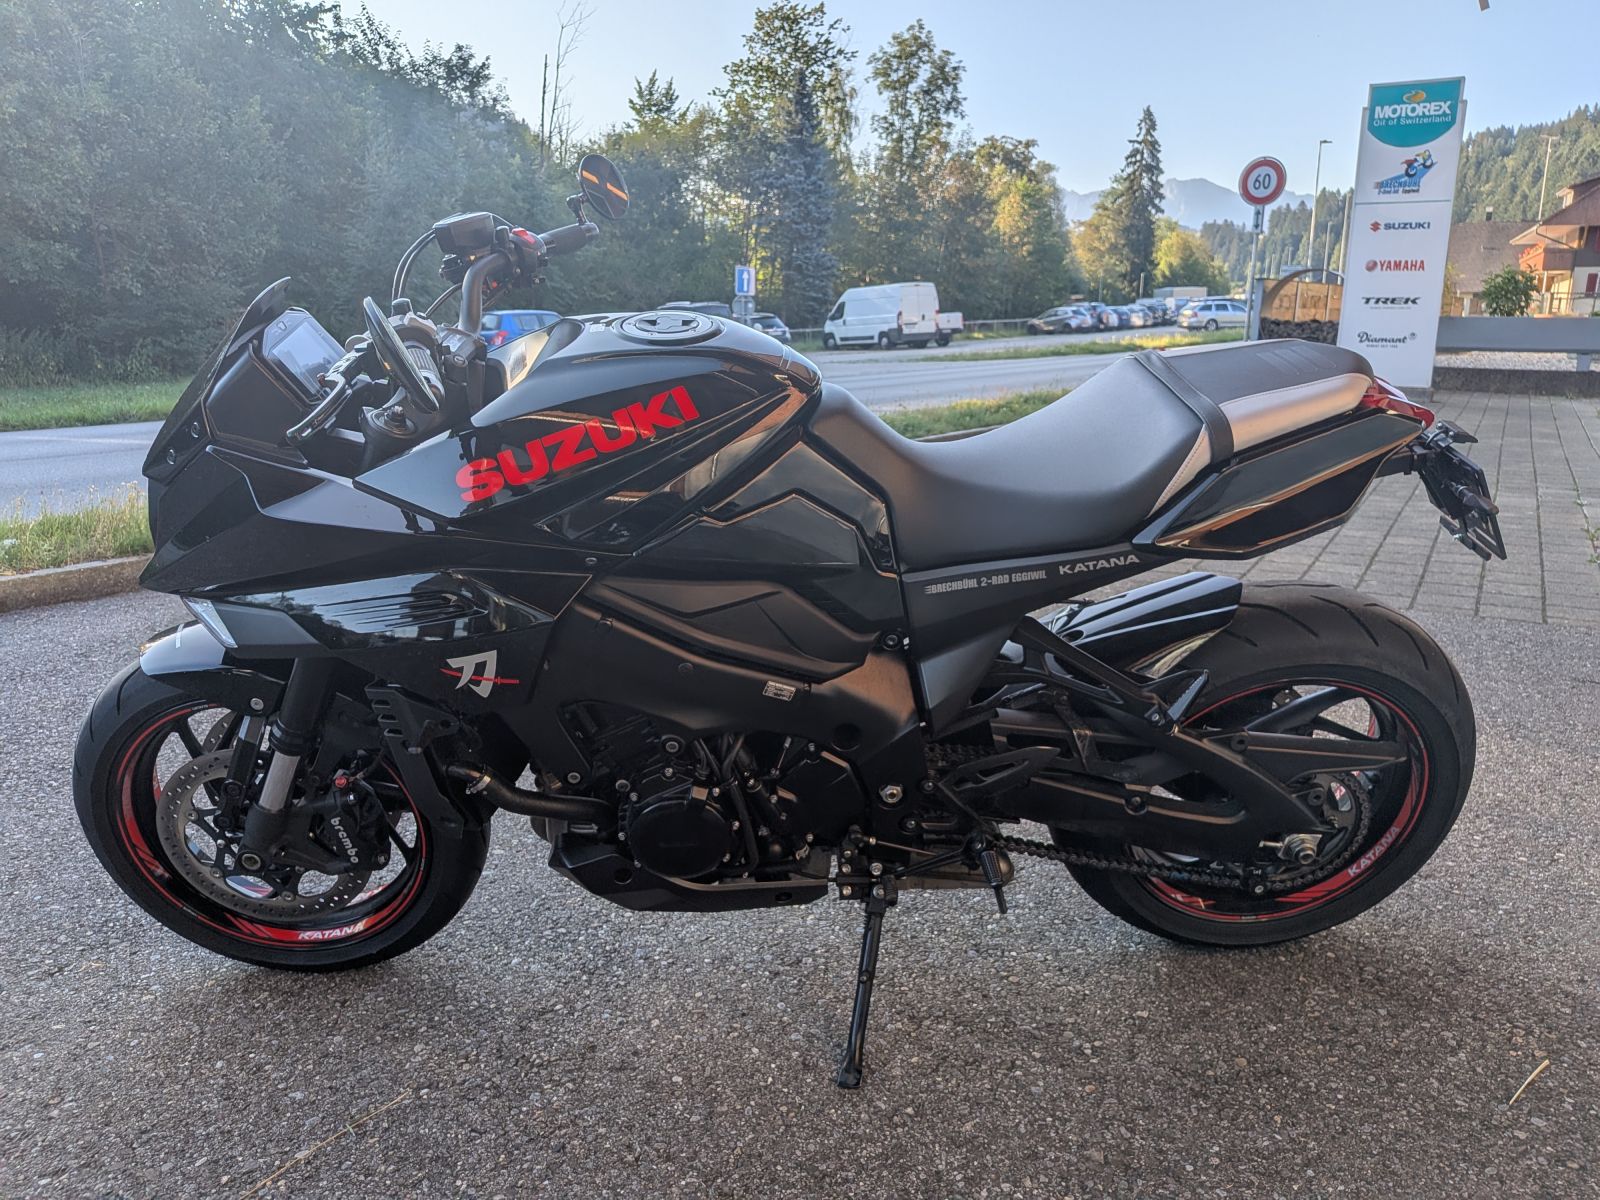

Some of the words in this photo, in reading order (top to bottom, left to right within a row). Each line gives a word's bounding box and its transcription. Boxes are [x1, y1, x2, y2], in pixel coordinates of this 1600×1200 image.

[1374, 101, 1452, 119] MOTOREX
[1388, 118, 1397, 126] of
[1400, 115, 1452, 126] Switzerland
[1253, 173, 1271, 190] 60
[1383, 221, 1431, 230] SUZUKI
[1379, 259, 1425, 272] YAMAHA
[1361, 296, 1421, 305] TREK
[1357, 331, 1408, 343] Diamant
[455, 385, 699, 502] SUZUKI
[1058, 554, 1140, 575] KATANA
[929, 577, 978, 594] BRECHBÜHL
[980, 573, 1010, 587] 2-RAD
[1011, 570, 1047, 583] EGGIWIL
[330, 816, 359, 863] brembo
[1347, 826, 1400, 877] KATANA
[298, 918, 367, 940] KATANA
